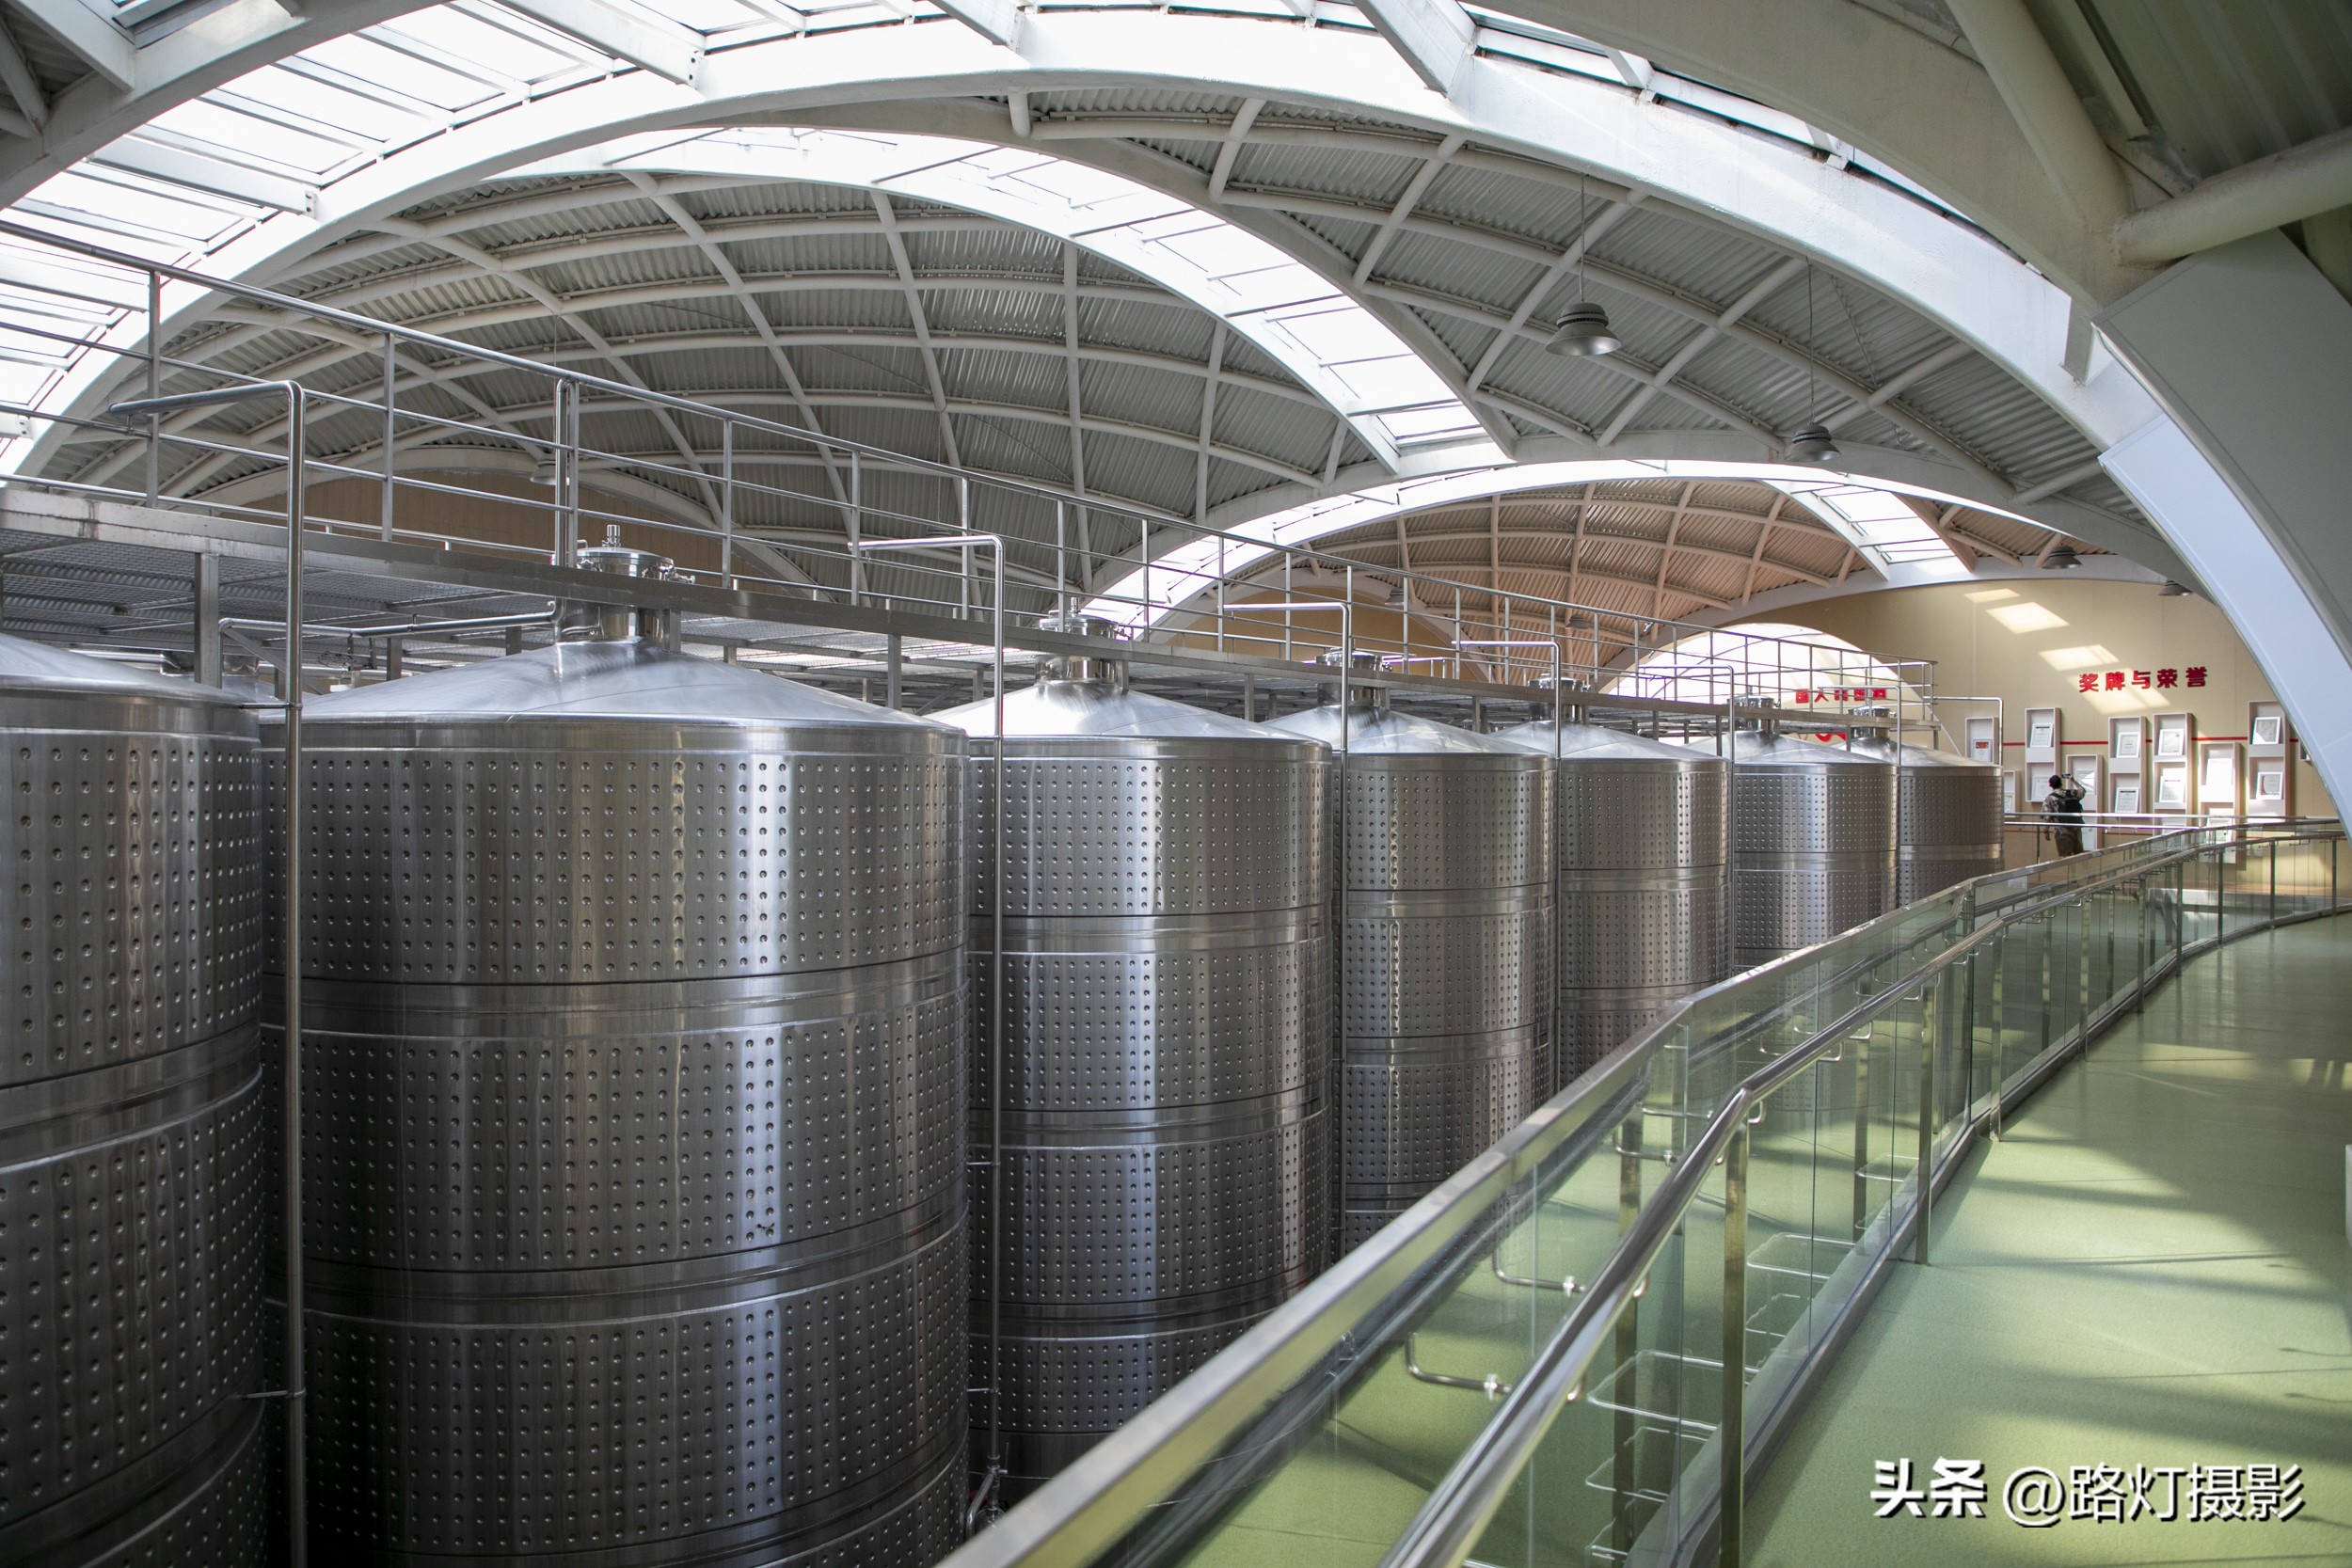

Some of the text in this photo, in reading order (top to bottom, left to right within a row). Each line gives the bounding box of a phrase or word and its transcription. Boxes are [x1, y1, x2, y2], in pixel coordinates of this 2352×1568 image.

[2078, 666, 2208, 693] 奖牌与荣誉
